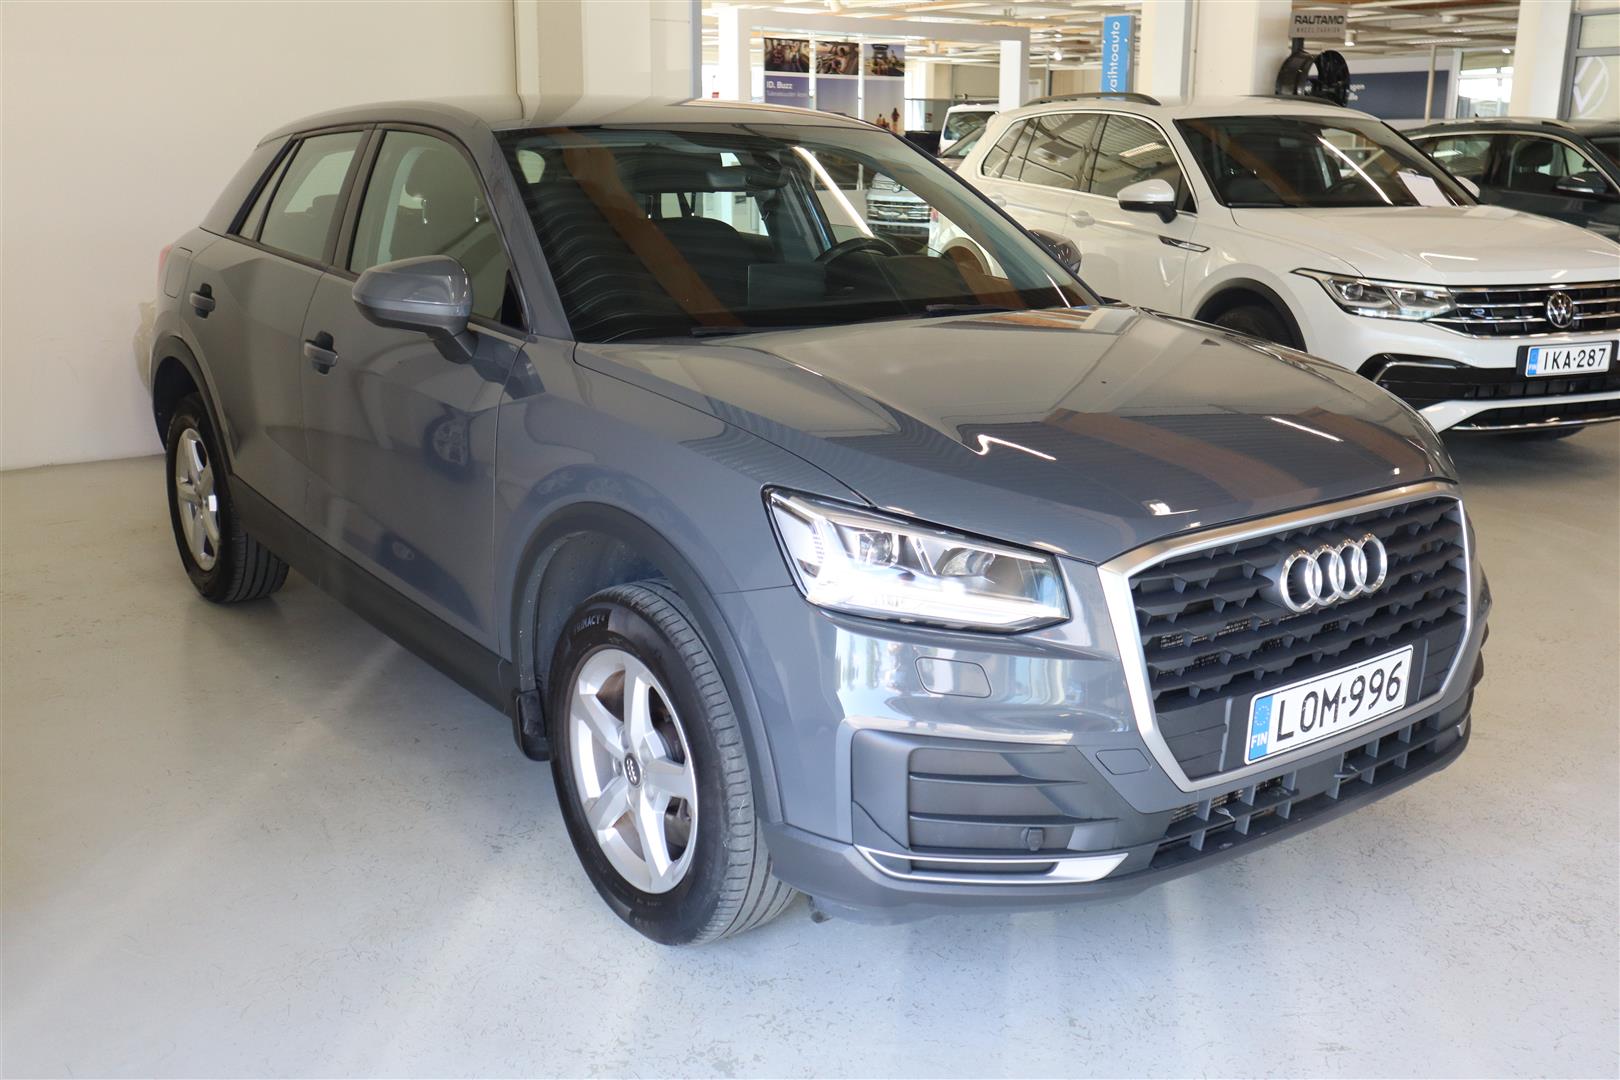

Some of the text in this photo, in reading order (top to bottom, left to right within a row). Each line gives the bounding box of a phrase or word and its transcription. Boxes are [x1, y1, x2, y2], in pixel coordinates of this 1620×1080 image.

[1294, 15, 1345, 25] RAUTAMO
[1544, 348, 1606, 370] IKA-287
[1276, 660, 1403, 742] LOM-996
[1250, 732, 1268, 749] FIN
